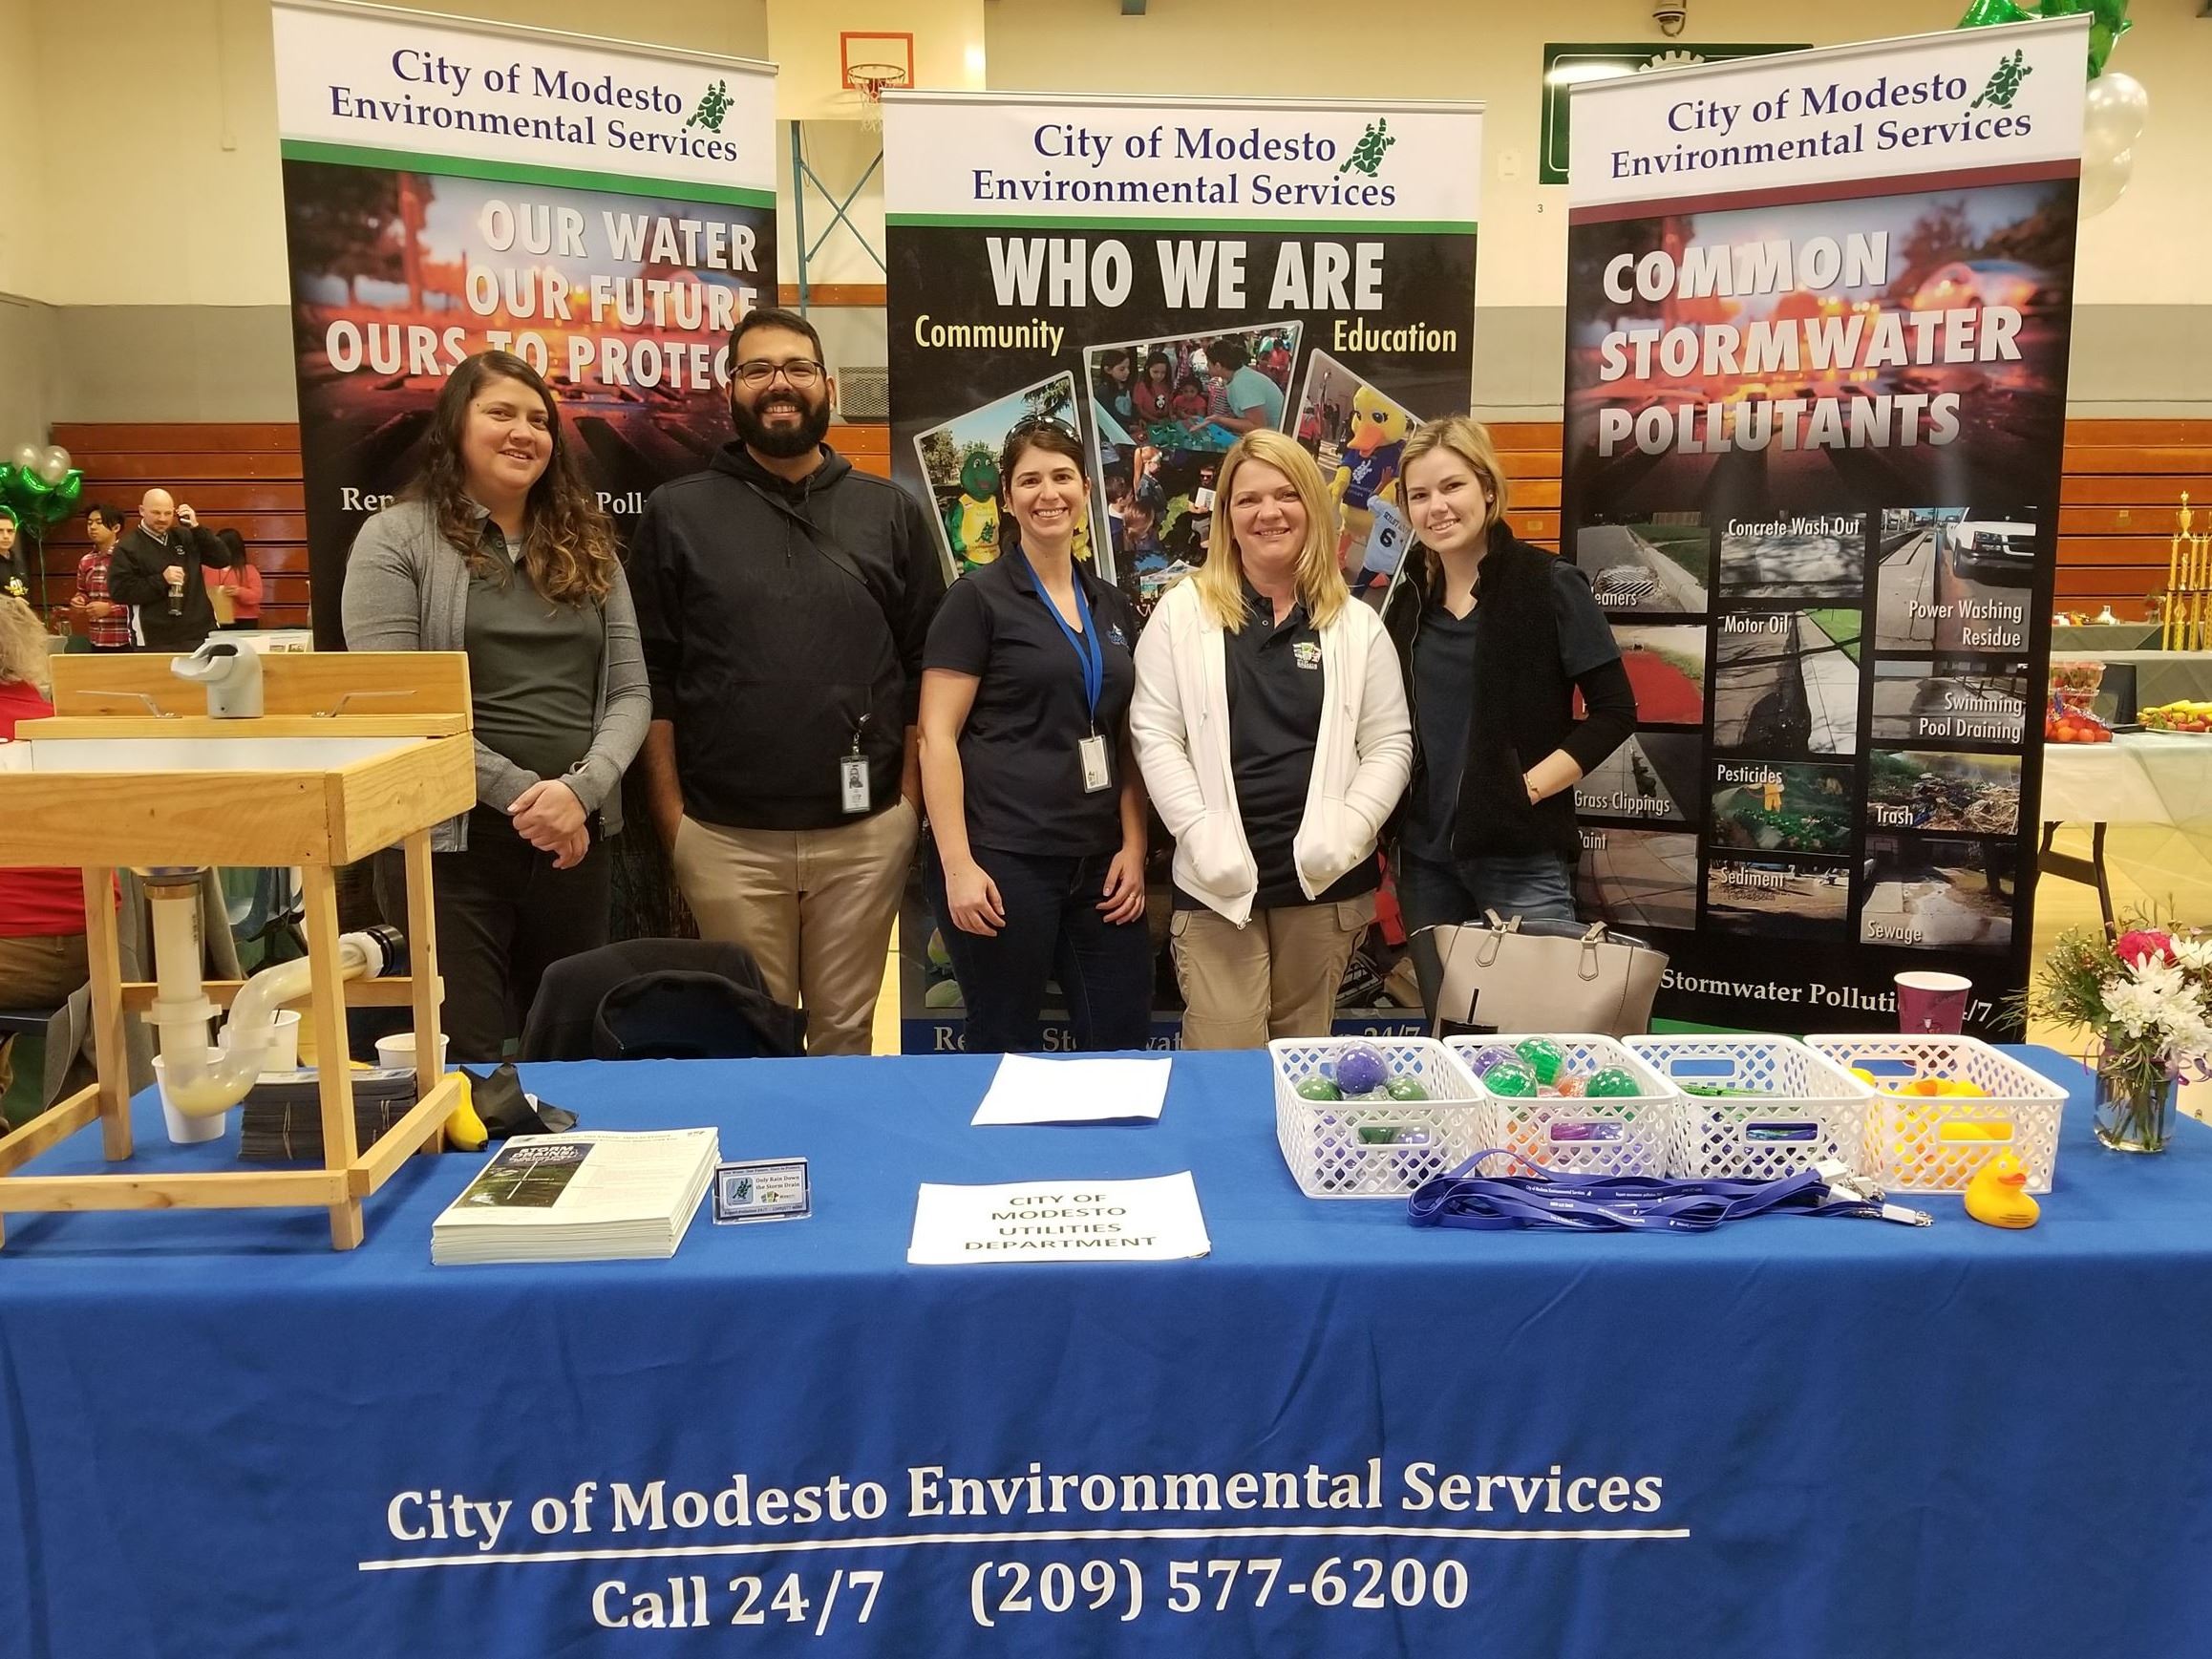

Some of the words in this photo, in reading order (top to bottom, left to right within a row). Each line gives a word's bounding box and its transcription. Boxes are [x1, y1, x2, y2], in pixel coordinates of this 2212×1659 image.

[392, 49, 472, 96] City
[483, 63, 520, 93] of
[532, 67, 682, 115] Modesto
[1668, 102, 1740, 138] City
[1752, 91, 1790, 123] of
[1799, 74, 1967, 117] Modesto
[329, 85, 596, 145] Environmental
[607, 119, 737, 161] Services
[1033, 124, 1114, 168] City
[1125, 126, 1162, 160] of
[1175, 127, 1336, 162] Modesto
[1611, 123, 1864, 179] Environmental
[1876, 112, 2031, 150] Services
[972, 170, 1239, 203] Environmental
[1251, 174, 1396, 207] Services
[1537, 203, 1543, 213] 3
[481, 199, 587, 258] OUR
[603, 210, 758, 273] WATER
[986, 237, 1134, 308] WHO
[1156, 239, 1247, 309] WE
[1267, 241, 1385, 310] ARE
[1603, 231, 1889, 304] COMMON
[466, 265, 573, 322] OUR
[590, 275, 758, 331] FUTURE
[915, 314, 1064, 356] Community
[1333, 319, 1457, 352] Education
[1600, 306, 2023, 381] STORMWATER
[326, 320, 467, 376] OURS
[568, 335, 732, 390] PROTEC
[1598, 393, 1962, 457] POLLUTANTS
[1379, 527, 1397, 548] 6
[1728, 518, 1788, 537] Concrete
[1793, 518, 1831, 536] Wash
[1834, 517, 1860, 536] Out
[1591, 586, 1637, 606] eaners
[1724, 615, 1764, 634] Motor
[1767, 615, 1789, 633] Oil
[1909, 601, 1954, 619] Power
[1958, 603, 2023, 625] Washing
[1962, 627, 2022, 648] Residue
[1945, 693, 2023, 715] Swimming
[1919, 718, 1952, 736] Pool
[1956, 720, 2022, 743] Draining
[1717, 765, 1782, 785] Pesticides
[1575, 790, 1608, 808] Grass
[1612, 791, 1670, 816] Clippings
[1876, 806, 1914, 826] Trash
[1720, 867, 1784, 888] Sediment
[1867, 921, 1923, 944] Sewage
[1660, 969, 1803, 1005] Stormwater
[1809, 984, 1899, 1013] Polluti
[991, 1207, 1127, 1221] MODESTO
[1010, 1195, 1065, 1205] CITY
[1074, 1194, 1108, 1203] OF
[965, 1236, 1158, 1251] DEPARTMENT
[999, 1223, 1122, 1236] UTILITIES
[387, 1489, 512, 1550] City
[530, 1481, 597, 1536] of
[610, 1474, 888, 1534] Modesto
[907, 1458, 1381, 1518] Environmental
[1403, 1461, 1663, 1514] Services
[592, 1574, 710, 1628] Call
[728, 1569, 884, 1636] 24/7
[970, 1558, 1143, 1627] (209)
[1168, 1557, 1469, 1613] 577-6200
